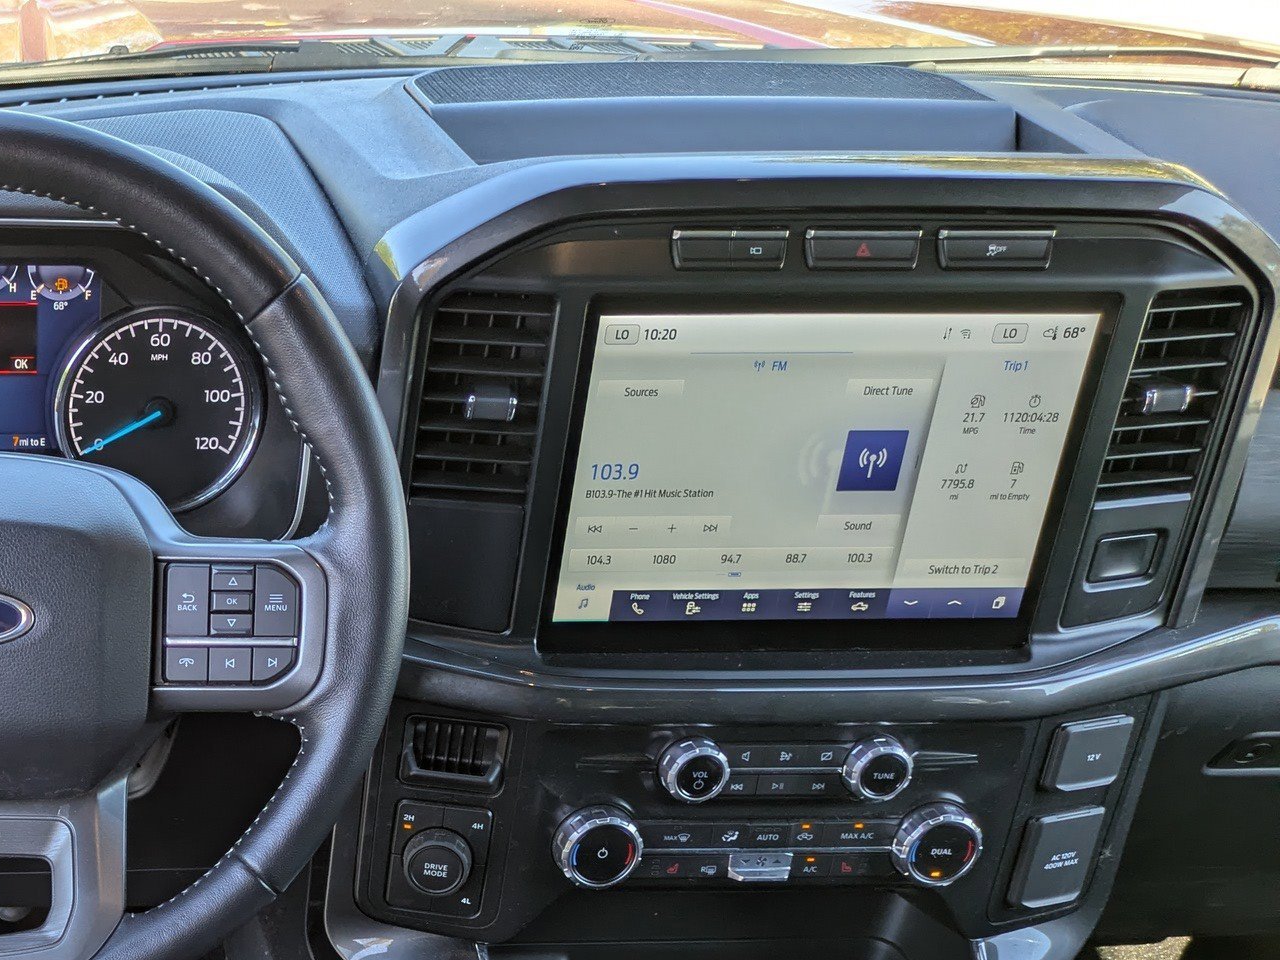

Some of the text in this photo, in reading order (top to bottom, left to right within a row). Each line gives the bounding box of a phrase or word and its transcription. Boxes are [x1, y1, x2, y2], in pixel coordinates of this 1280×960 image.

[9, 282, 17, 293] H
[30, 289, 37, 300] E
[85, 289, 92, 300] F
[614, 328, 678, 341] LO 10:20
[1002, 326, 1086, 339] LO 68°
[150, 333, 171, 347] 60
[108, 352, 129, 366] 40
[150, 353, 169, 361] MPH
[190, 351, 212, 365] 80
[14, 358, 29, 369] OK
[771, 360, 788, 371] FM
[1003, 360, 1029, 373] Trip 1
[204, 389, 230, 403] 100
[624, 387, 659, 397] Sources
[863, 386, 913, 396] Direct Tune
[85, 390, 105, 404] 20
[962, 412, 1059, 423] 21.7 1120:04:28
[962, 427, 1036, 435] MPG Time
[30, 438, 39, 447] to
[40, 437, 46, 447] E
[195, 437, 220, 450] 120
[591, 463, 640, 481] 103.9
[940, 479, 1017, 489] 7795.8 7
[644, 489, 657, 498] Hit
[658, 489, 681, 498] Music
[683, 488, 714, 498] Station
[949, 492, 959, 500] mi
[999, 493, 1007, 501] to
[1007, 493, 1030, 503] Empty
[844, 521, 872, 531] Sound
[586, 555, 612, 565] 104.3
[652, 555, 676, 565] 1080
[720, 554, 742, 564] 94.7
[785, 553, 807, 564] 88.7
[847, 553, 873, 563] 100.3
[928, 564, 998, 577] Switch to Trip 2
[576, 583, 596, 591] Audio
[630, 593, 650, 601] Phone
[673, 592, 719, 602] Vehicle Settings
[743, 592, 759, 601] Apps
[794, 591, 820, 600] Settings
[849, 590, 876, 599] Features
[226, 597, 238, 605] OK
[177, 604, 198, 612] BACK
[264, 604, 288, 612] MENU
[692, 771, 709, 780] VOL
[872, 772, 895, 781] TUNE
[403, 813, 415, 822] 2H
[471, 822, 484, 831] 4H
[756, 833, 780, 842] AUTO
[840, 832, 874, 841] MAX A/C
[931, 847, 953, 856] DUAL
[1051, 854, 1061, 862] AC
[1063, 858, 1079, 868] MAX
[424, 862, 449, 872] DRIVE
[803, 864, 818, 873] A/C
[423, 869, 448, 878] MODE
[460, 897, 472, 905] 4L
